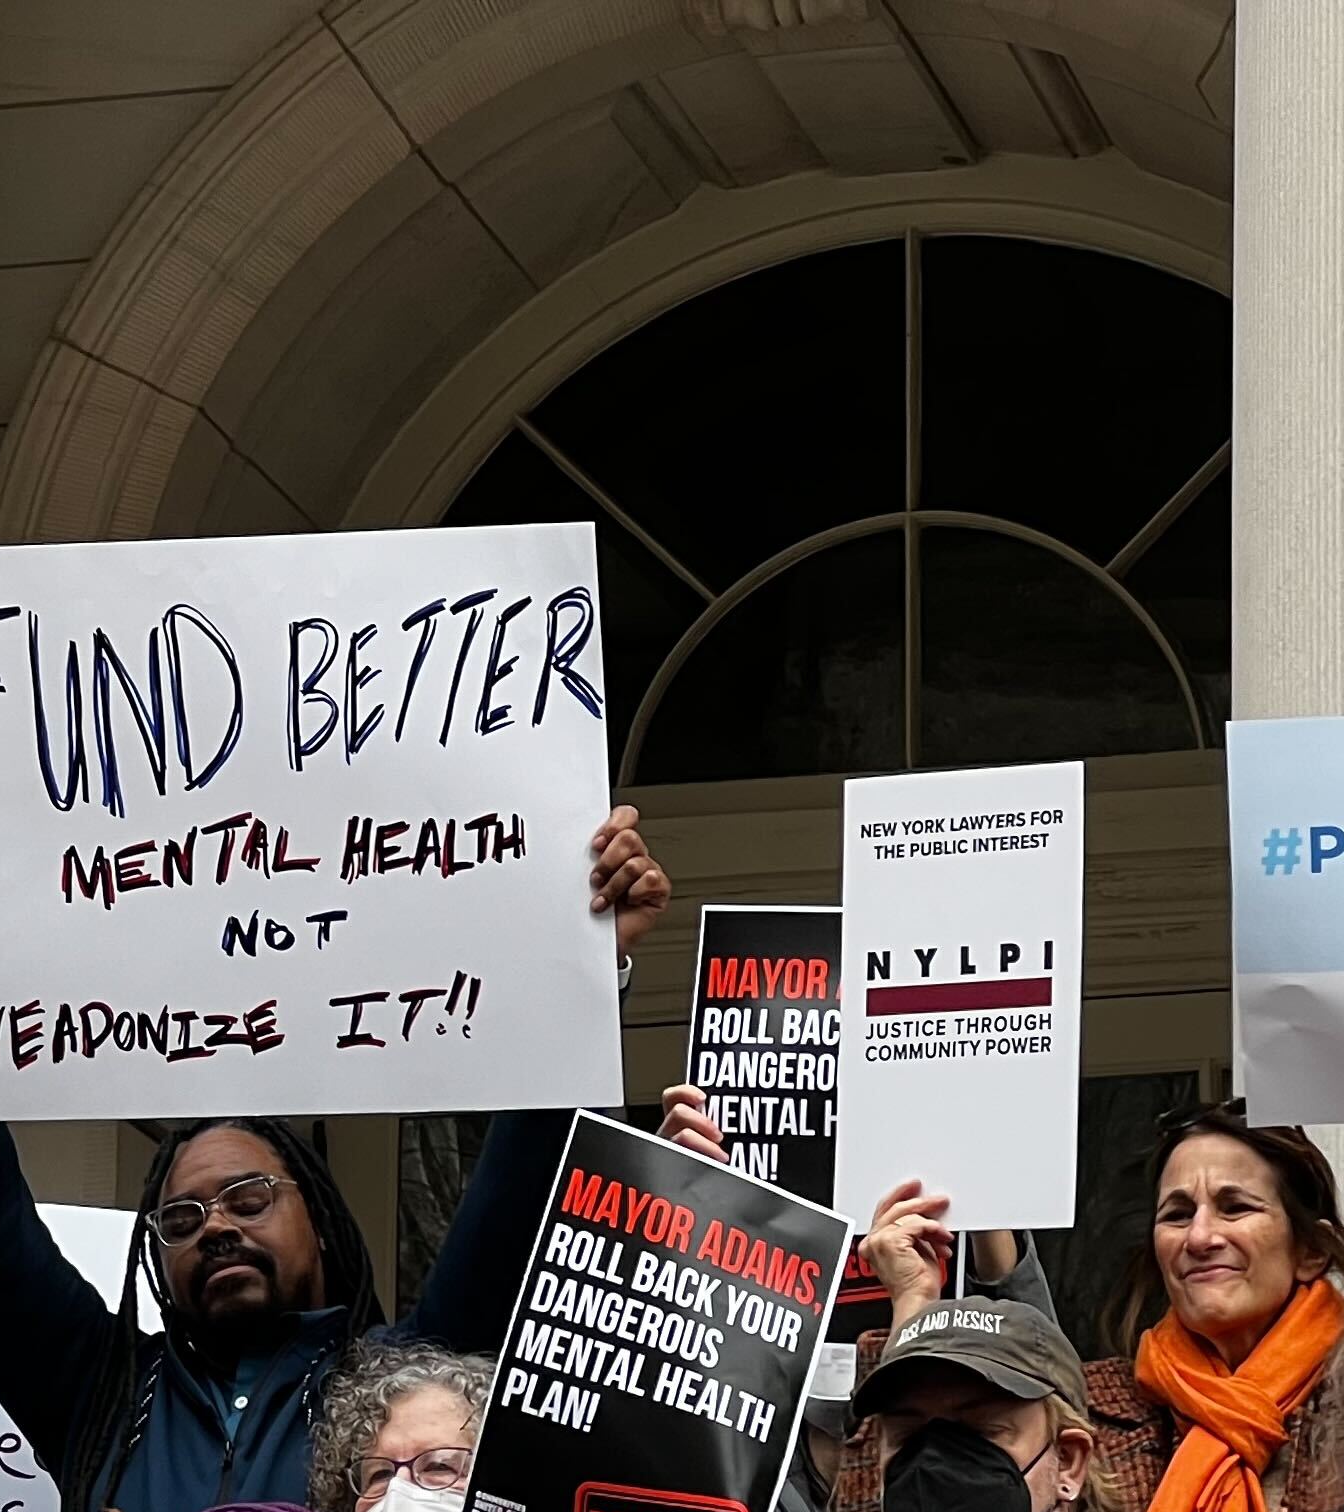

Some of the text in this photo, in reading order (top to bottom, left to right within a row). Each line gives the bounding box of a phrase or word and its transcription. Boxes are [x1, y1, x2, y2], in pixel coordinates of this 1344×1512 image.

[288, 586, 602, 770] BETTER
[860, 810, 1063, 840] NEW YORK LAWYERS FOR
[874, 833, 1049, 860] THE PUBLIC INTEREST
[61, 812, 527, 909] MENTAL HEALTH
[222, 910, 347, 957] NOT
[707, 957, 827, 999] MAYOR
[701, 1008, 772, 1043] ROLL
[865, 1015, 1052, 1040] JUSTICE THROUGH
[865, 1036, 1051, 1063] COMMUNITY POWER
[561, 1167, 823, 1316] MAYOR ADAMS,
[545, 1222, 803, 1353] ROLL BACK YOUR
[530, 1271, 725, 1369] DANGEROUS
[921, 1309, 1004, 1334] AND RESIST
[501, 1368, 600, 1433] PLAN!
[514, 1319, 777, 1443] MENTAL HEALTH
